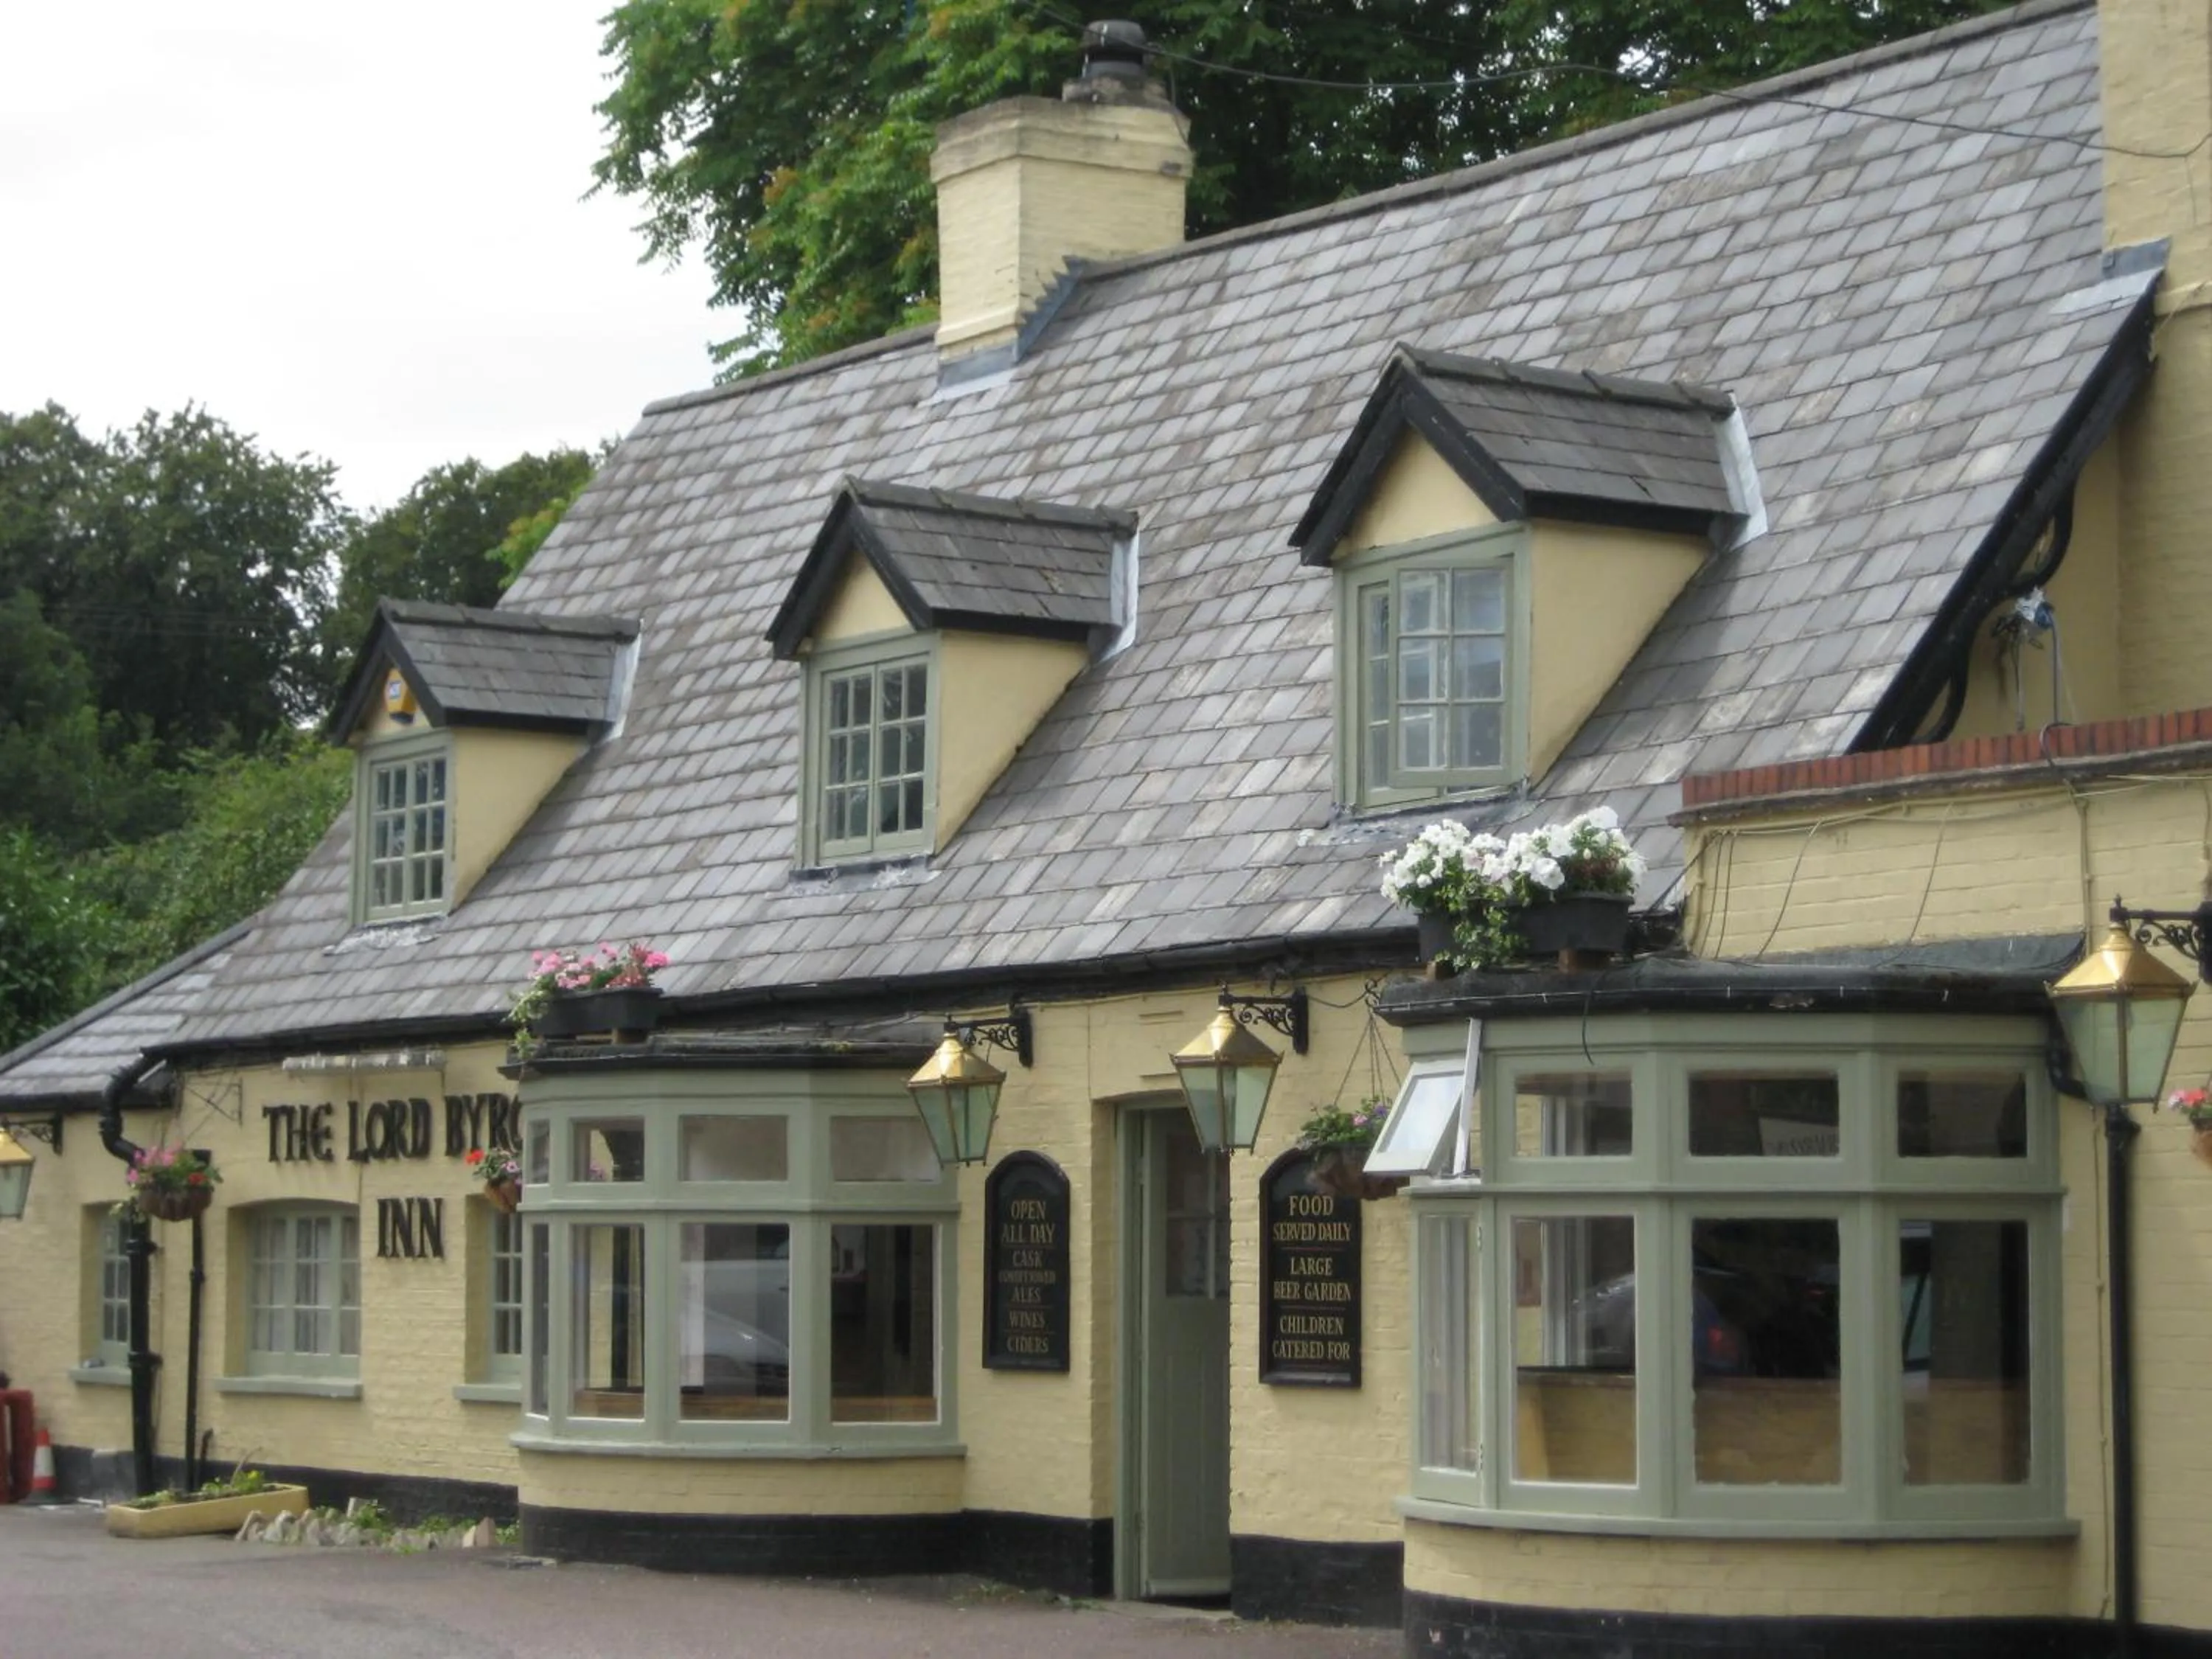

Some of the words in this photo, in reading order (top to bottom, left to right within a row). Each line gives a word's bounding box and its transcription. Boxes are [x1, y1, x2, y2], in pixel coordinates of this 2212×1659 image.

[262, 1104, 334, 1162] THE
[347, 1097, 432, 1164] LORD
[1010, 1200, 1046, 1220] OPEN
[1288, 1194, 1332, 1216] FOOD
[377, 1197, 445, 1258] INN
[1001, 1223, 1025, 1243] ALL
[1029, 1222, 1054, 1243] DAY
[1273, 1222, 1315, 1240] SERVED
[1318, 1221, 1350, 1241] DAILY
[1012, 1249, 1041, 1267] CASK
[1290, 1256, 1332, 1276] LARGE
[1011, 1286, 1040, 1303] ALES
[1273, 1281, 1299, 1299] BEER
[1304, 1281, 1350, 1301] GARDEN
[1009, 1310, 1044, 1328] WINES
[1279, 1315, 1343, 1335] CHILDREN
[1006, 1335, 1047, 1353] CIDERS
[1273, 1339, 1324, 1358] CATERED
[1327, 1340, 1349, 1359] FOR
